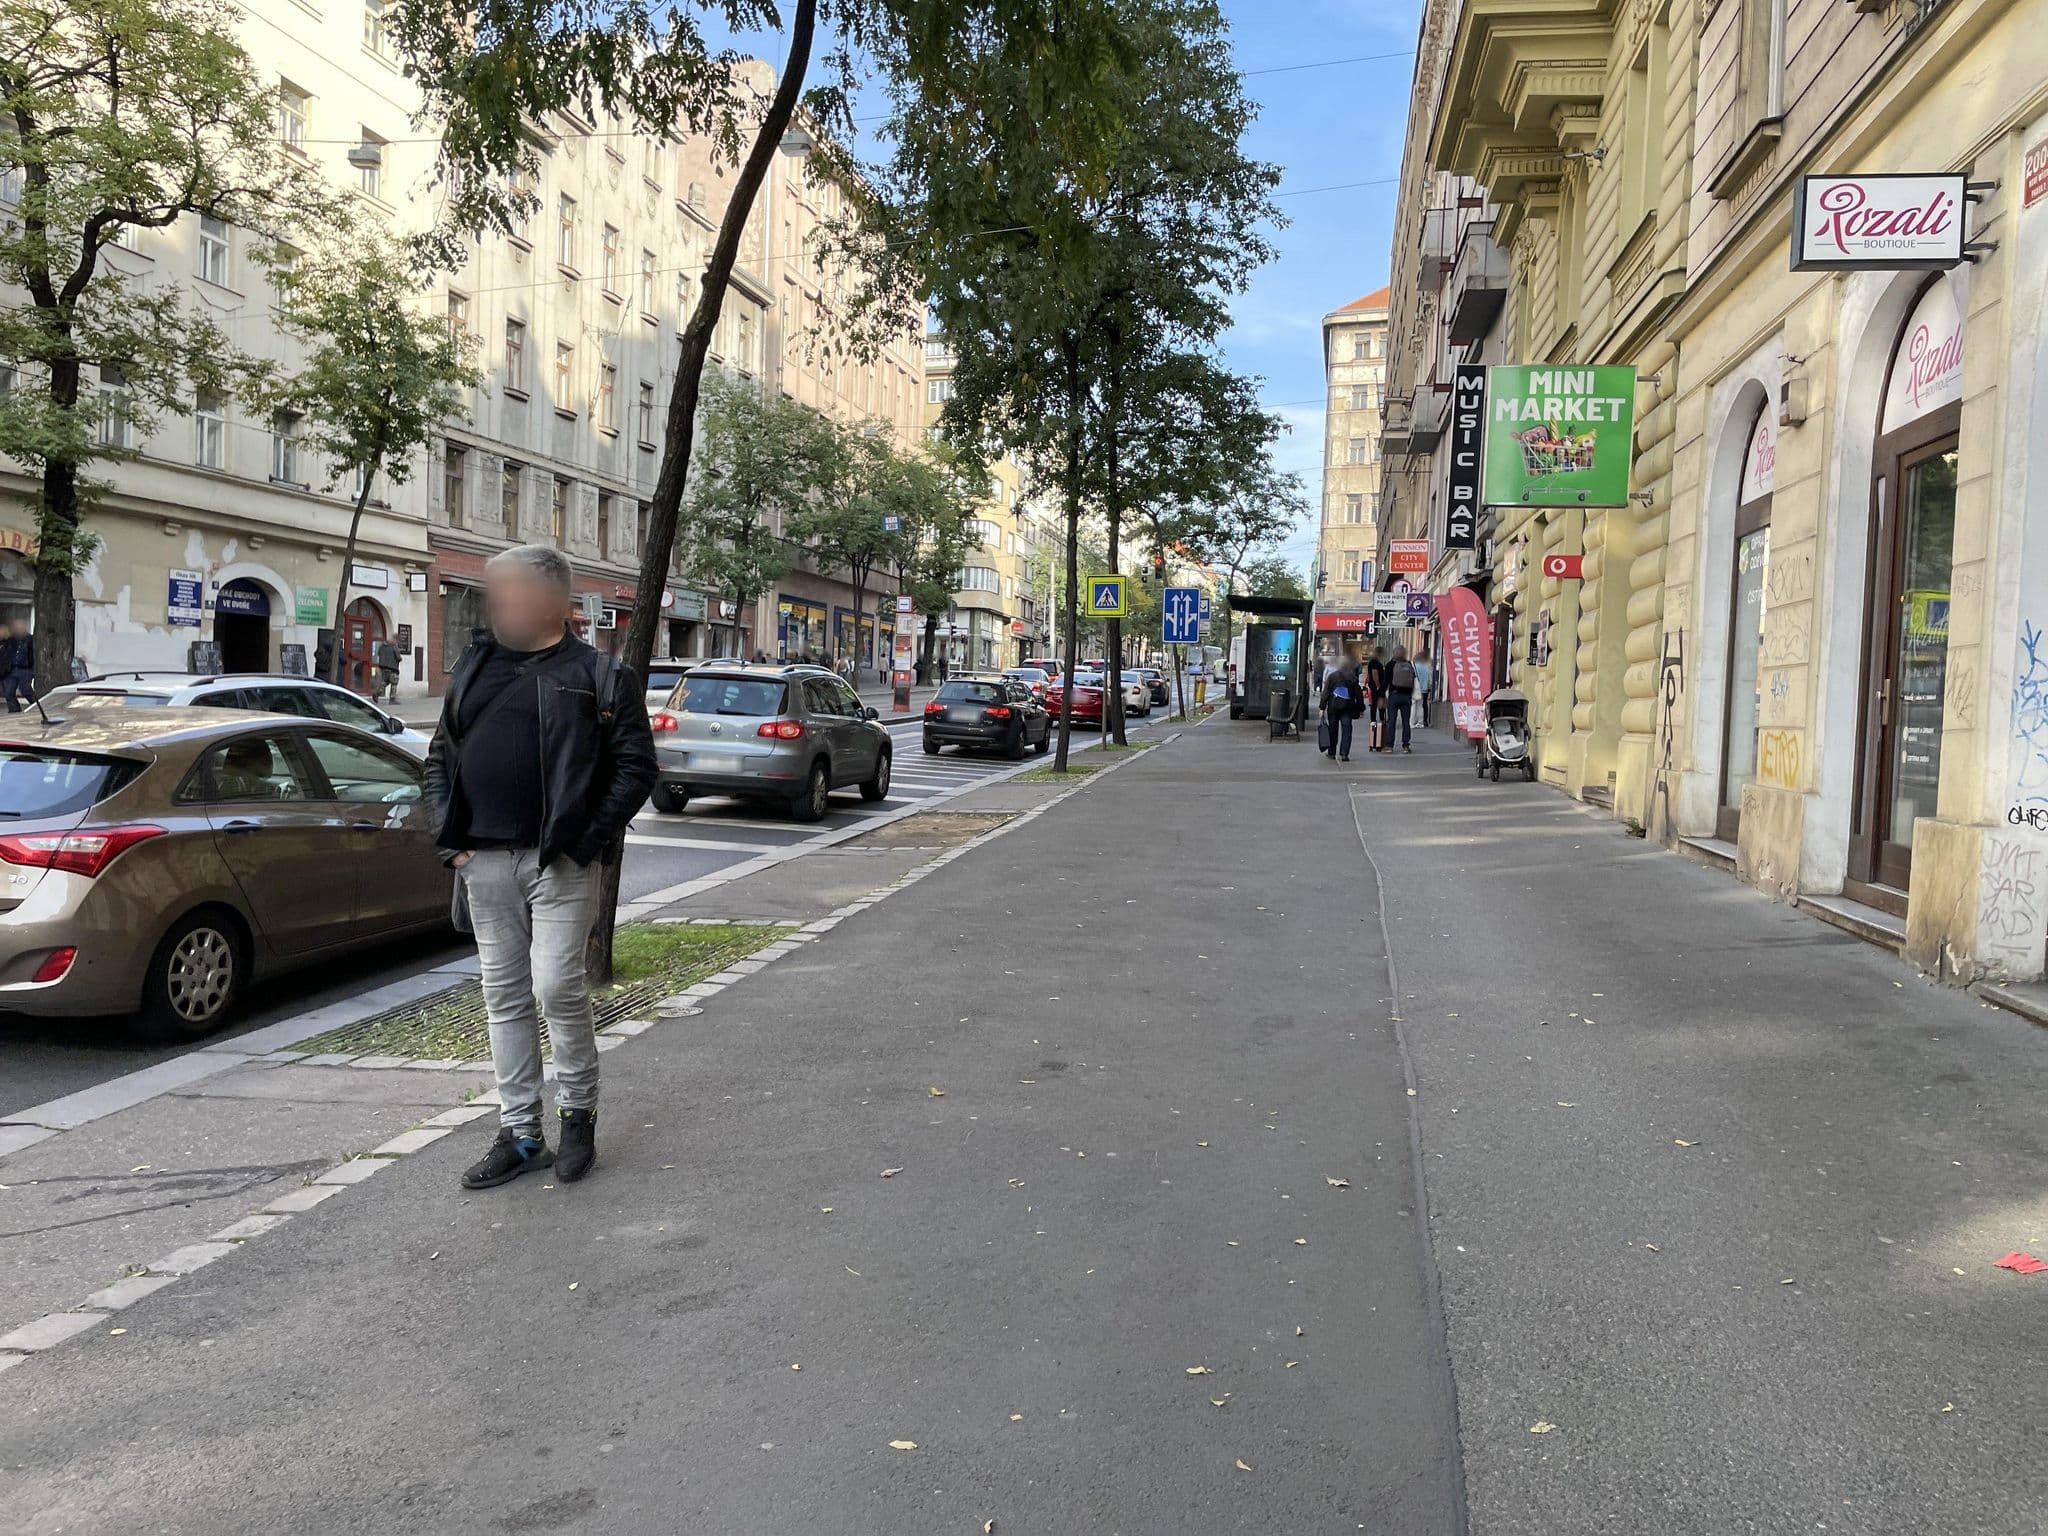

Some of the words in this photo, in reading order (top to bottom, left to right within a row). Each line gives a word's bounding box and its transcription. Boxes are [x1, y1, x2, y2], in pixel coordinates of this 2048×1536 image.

[2026, 144, 2048, 178] 200
[1814, 183, 1954, 254] Rozali
[1864, 238, 1917, 249] BOUTIQUE
[1529, 371, 1595, 395] MINI
[1457, 376, 1483, 467] MUSIC
[1495, 398, 1626, 422] MARKET
[1451, 486, 1472, 537] BAR
